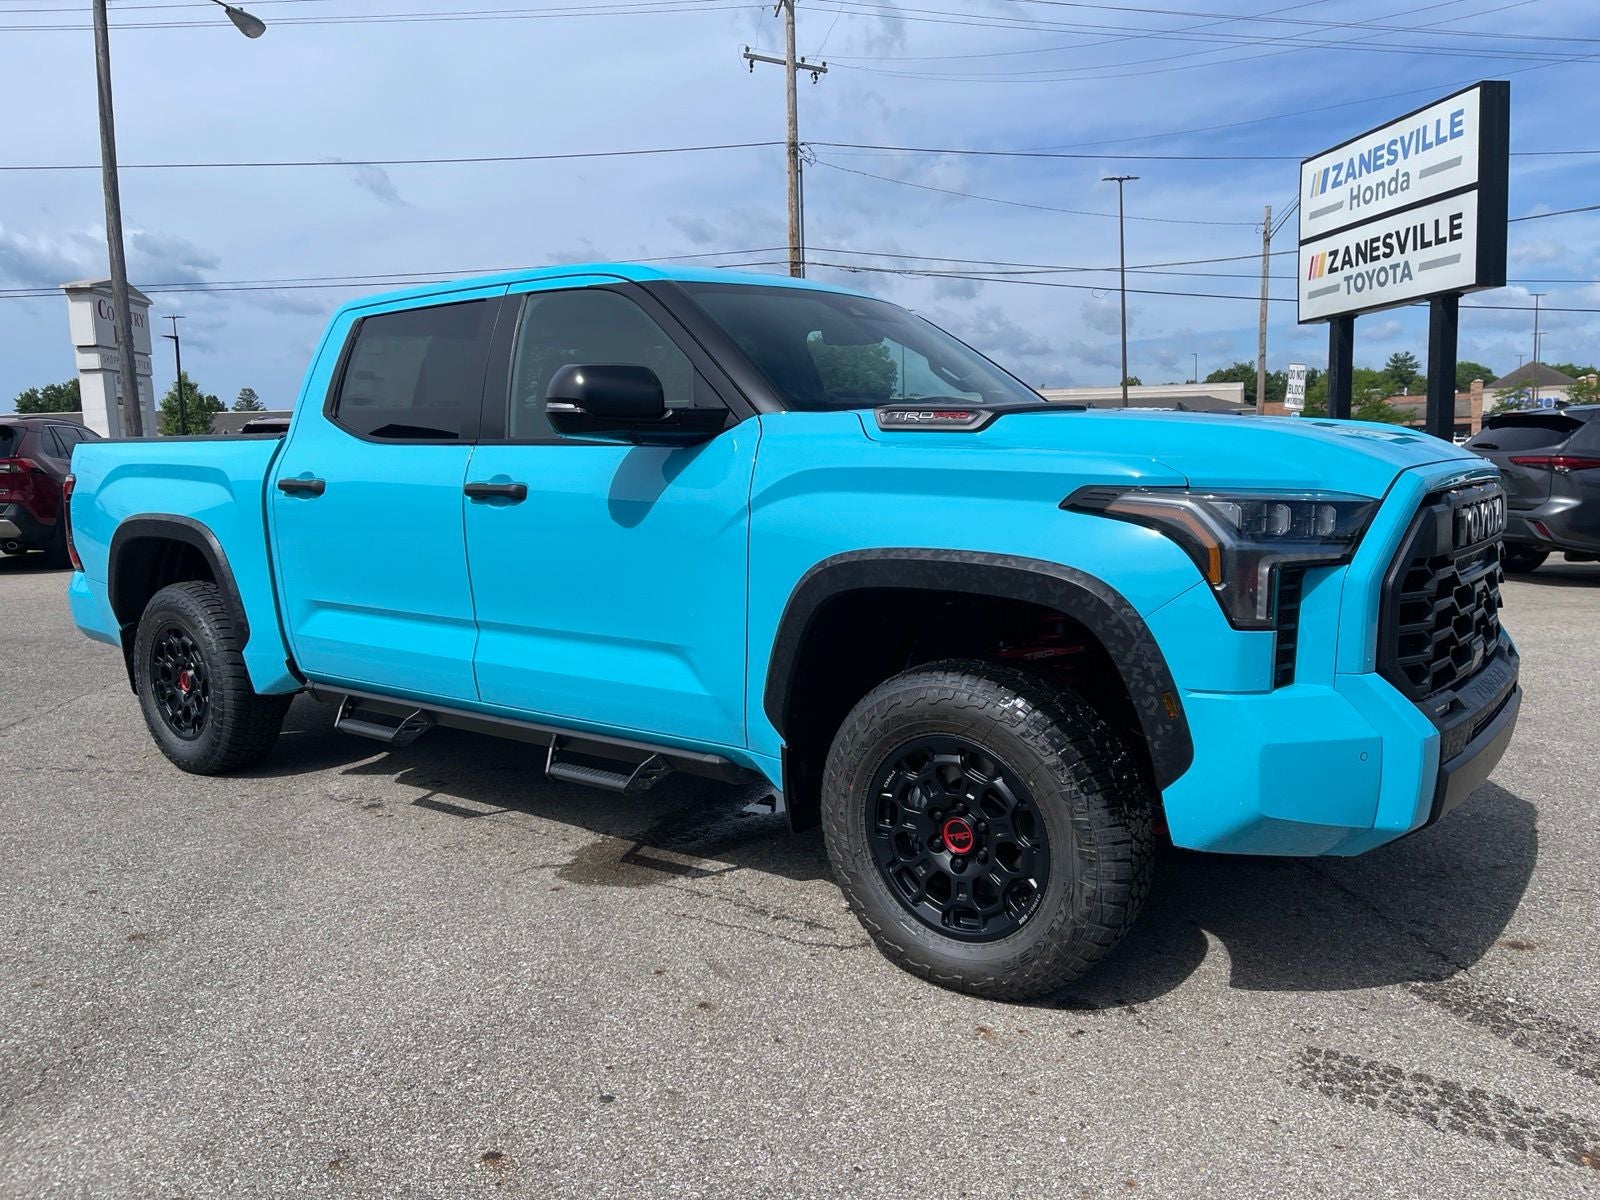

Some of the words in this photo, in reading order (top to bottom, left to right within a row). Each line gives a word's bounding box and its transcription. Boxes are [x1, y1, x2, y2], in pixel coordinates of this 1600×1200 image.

[1331, 108, 1464, 190] ZANESVILLE
[1350, 168, 1411, 210] Honda
[1327, 212, 1463, 274] ZANESVILLE
[1343, 260, 1413, 295] TOYOTA
[98, 299, 144, 328] COTRY
[893, 411, 934, 421] TRD
[934, 411, 970, 421] PRO
[1457, 499, 1503, 546] TOYOTA
[1024, 648, 1055, 660] TRD
[947, 831, 971, 842] TRD
